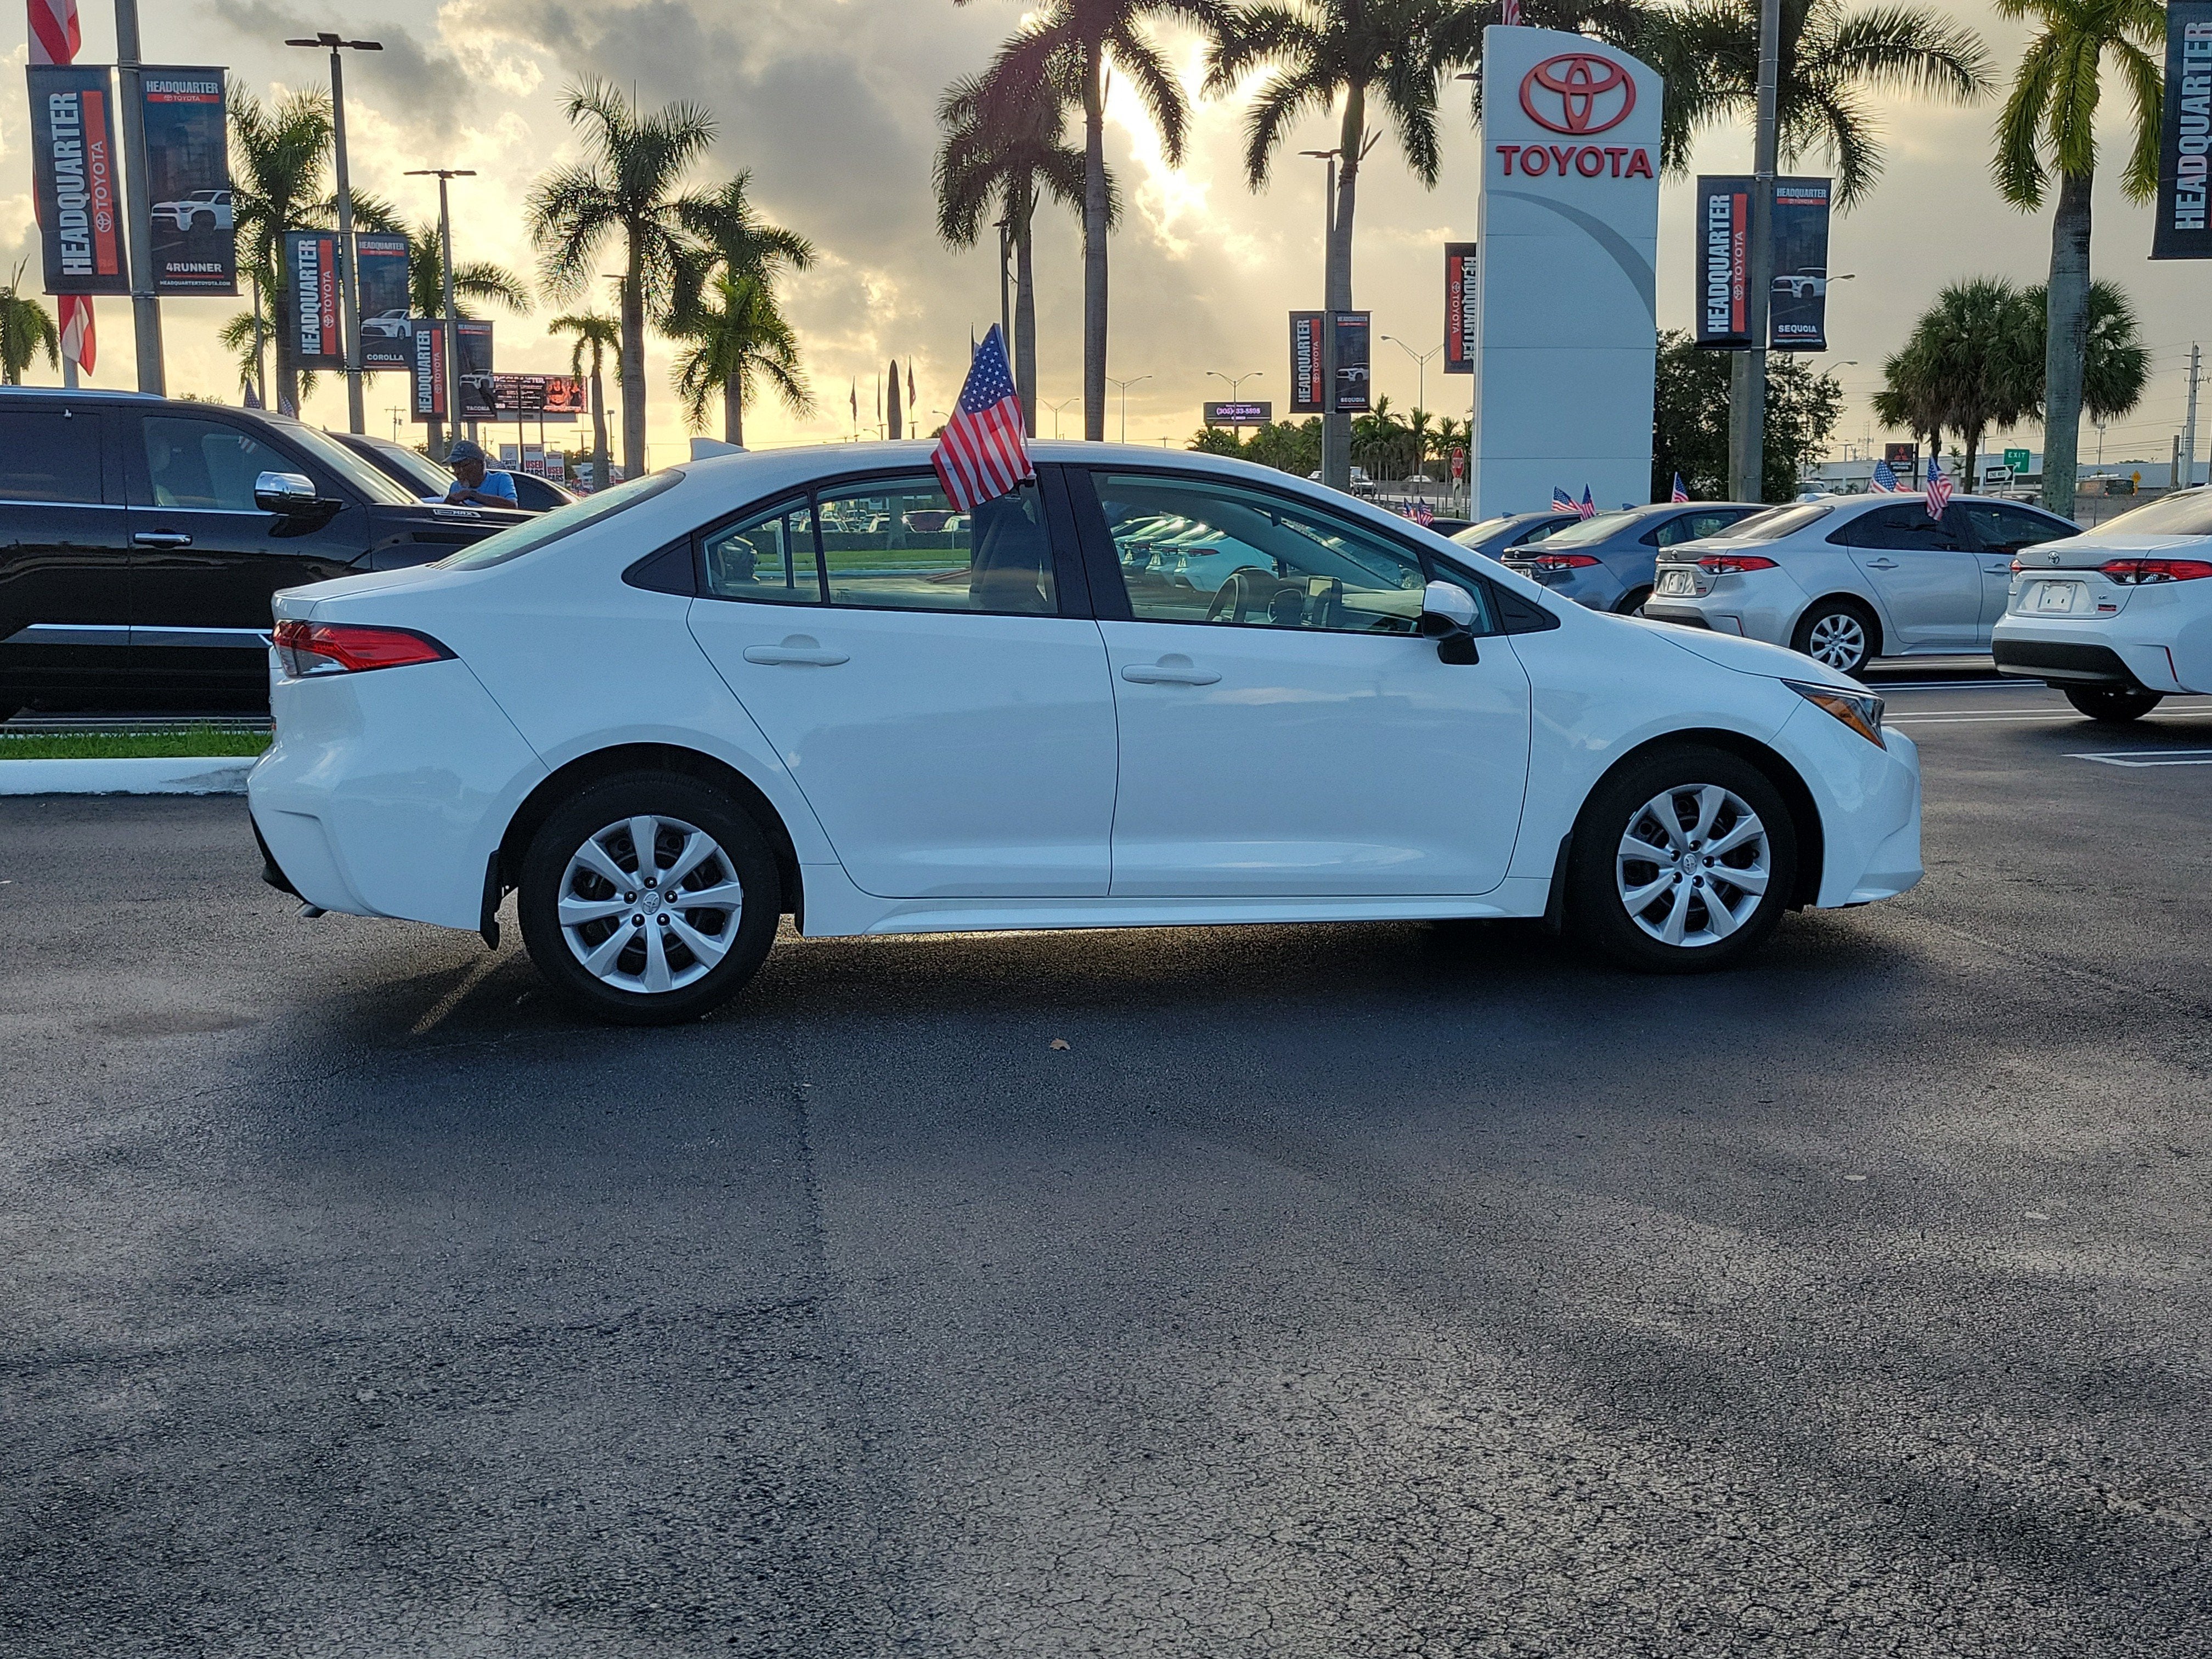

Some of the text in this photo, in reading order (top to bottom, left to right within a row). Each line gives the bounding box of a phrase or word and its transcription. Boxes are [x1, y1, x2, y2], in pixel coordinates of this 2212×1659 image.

[146, 81, 219, 94] HEADQUARTER
[2174, 22, 2212, 229] HEADQUARTER
[91, 140, 107, 211] TOYOTA
[1496, 145, 1654, 178] TOYOTA
[49, 93, 92, 275] HEADQUARTER
[1776, 188, 1826, 198] HEADQUARTER
[166, 262, 222, 272] 4RUNNER
[359, 241, 404, 250] HEADQUARTER
[1707, 194, 1732, 332] HEADQUARTER
[1735, 232, 1743, 283] TOYOTA
[298, 240, 321, 354] HEADQUARTER
[323, 270, 332, 313] TOYOTA
[1452, 295, 1460, 334] TOYOTA
[1778, 324, 1817, 334] SEQUOIA
[417, 330, 433, 413] HEADQUARTER
[1297, 319, 1312, 403] HEADQUARTER
[526, 460, 543, 469] USED
